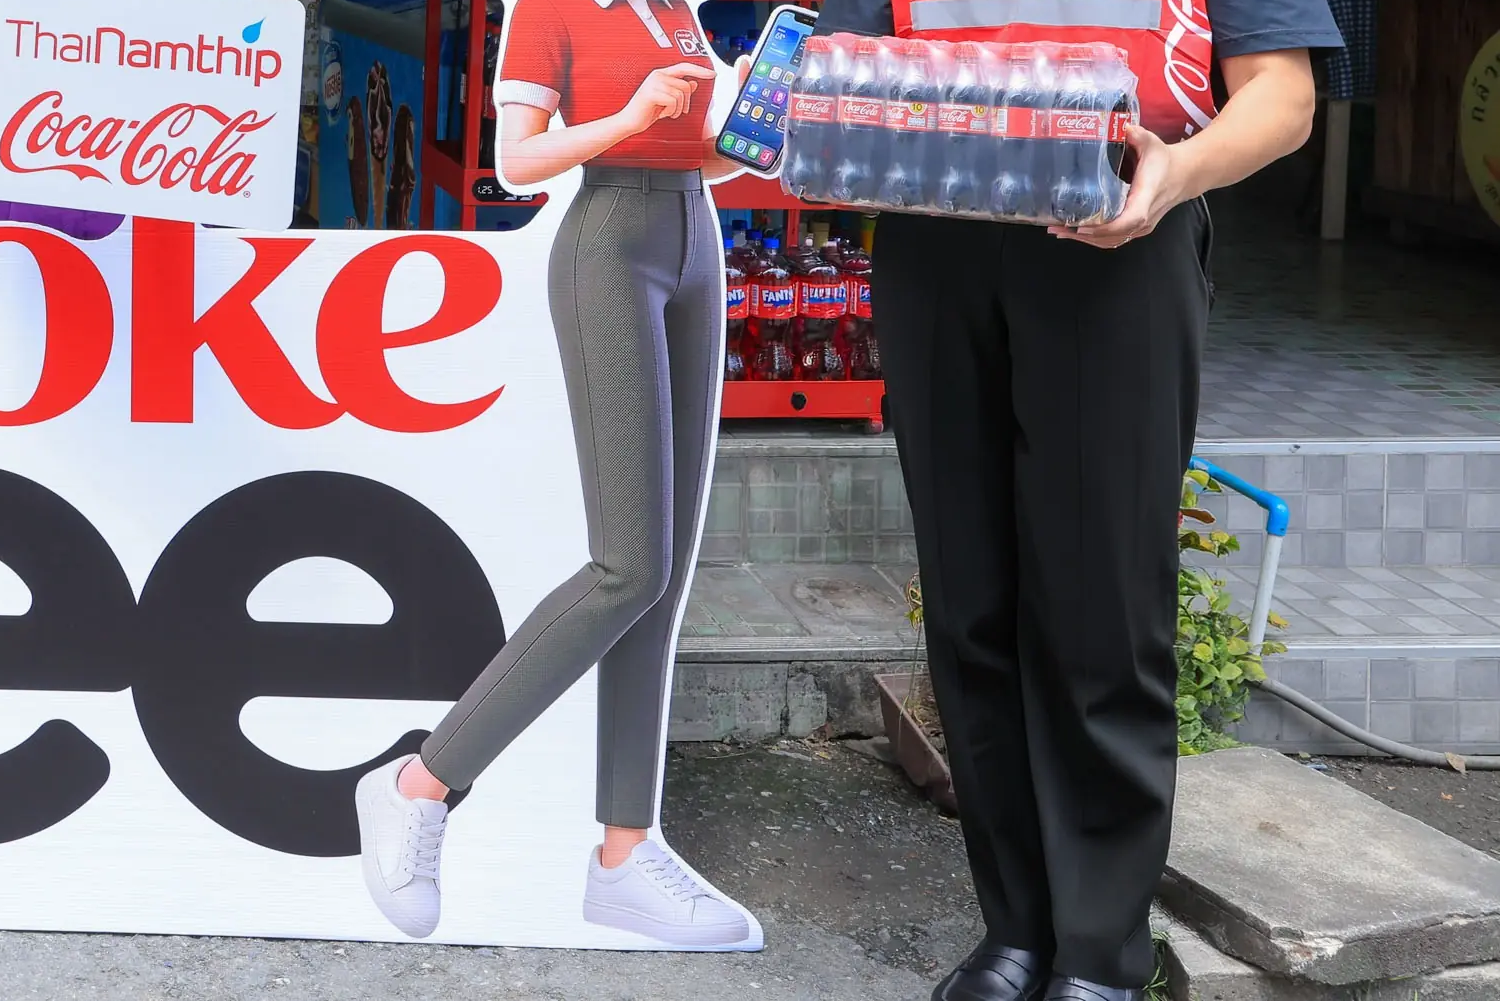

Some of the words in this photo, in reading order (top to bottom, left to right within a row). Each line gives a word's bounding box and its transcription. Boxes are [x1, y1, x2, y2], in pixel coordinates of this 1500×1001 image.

[974, 106, 985, 114] 10
[1056, 116, 1097, 130] Coca-Cola
[727, 288, 746, 301] NTA
